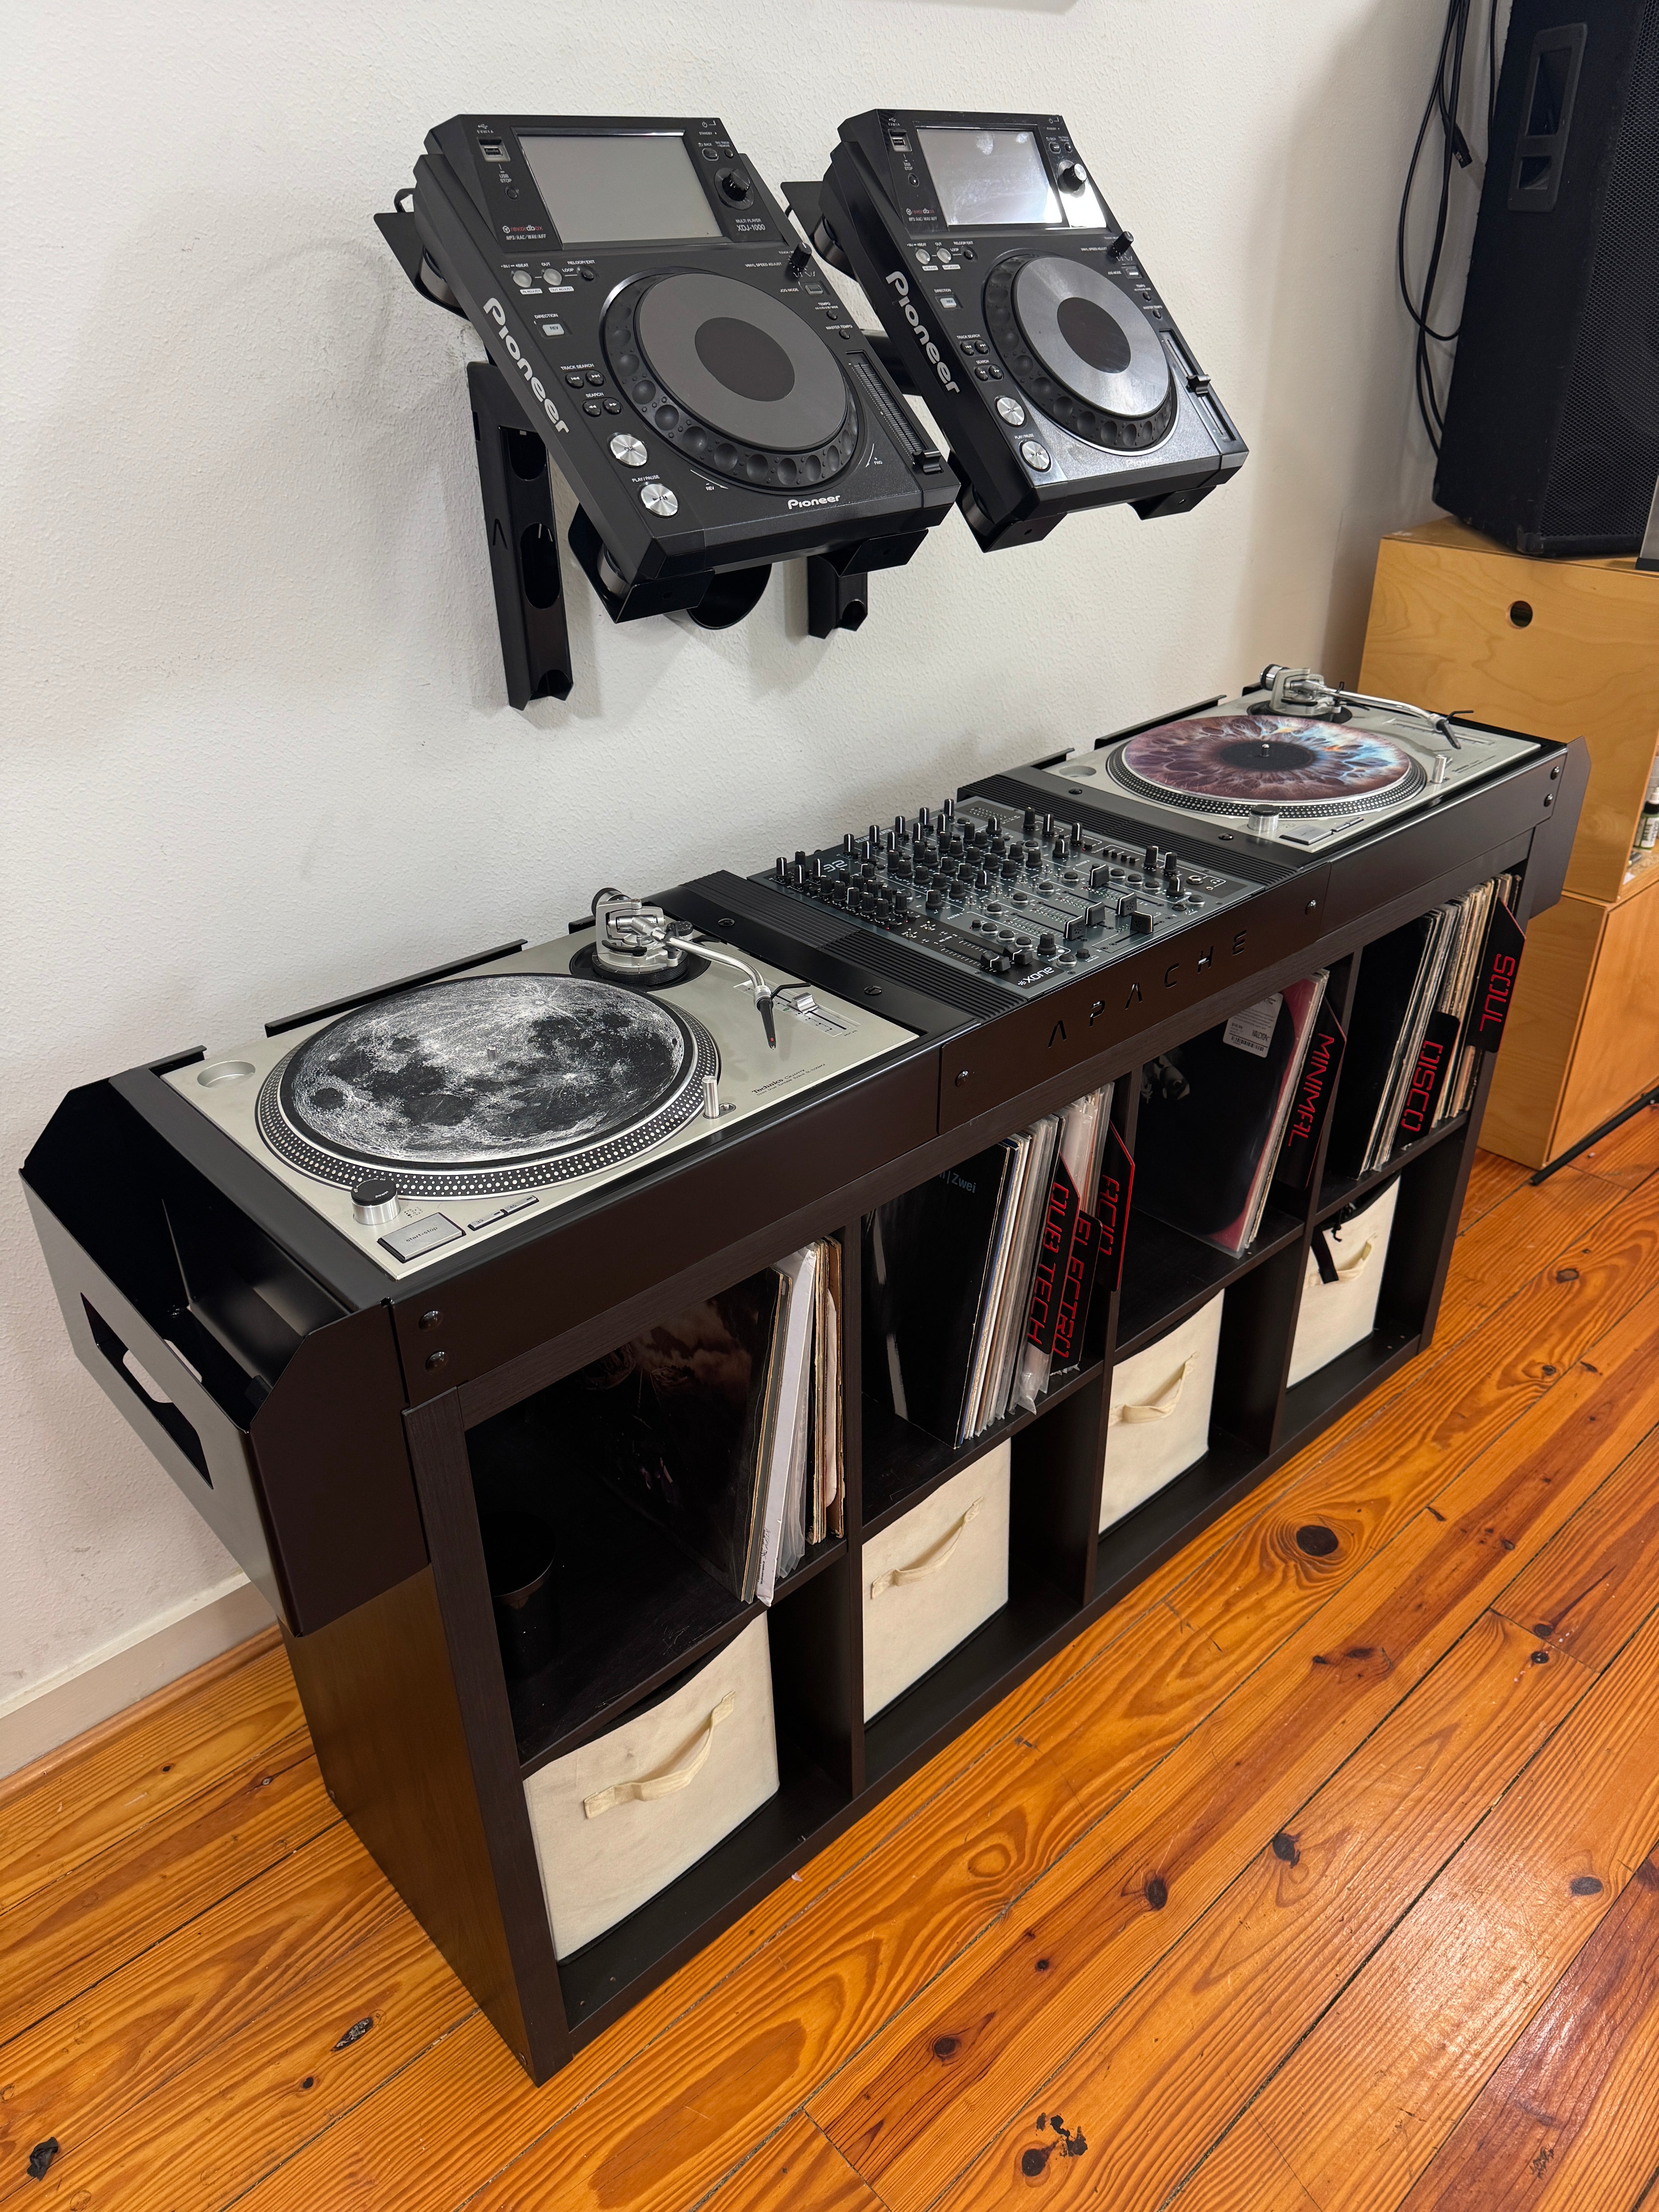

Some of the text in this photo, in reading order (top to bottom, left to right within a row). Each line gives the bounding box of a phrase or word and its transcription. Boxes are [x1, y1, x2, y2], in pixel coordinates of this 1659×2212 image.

[483, 298, 570, 433] Pioneer
[885, 271, 960, 393] Pioneer
[787, 495, 840, 510] Pioneer
[1479, 953, 1515, 1032] SOUL
[752, 1079, 783, 1093] Technics
[1288, 1033, 1335, 1147] MINIMAL
[1401, 1040, 1443, 1132] DISCO
[951, 1173, 976, 1193] Zwei
[1096, 1175, 1120, 1256] ACID
[1027, 1182, 1069, 1345] DUB TECH
